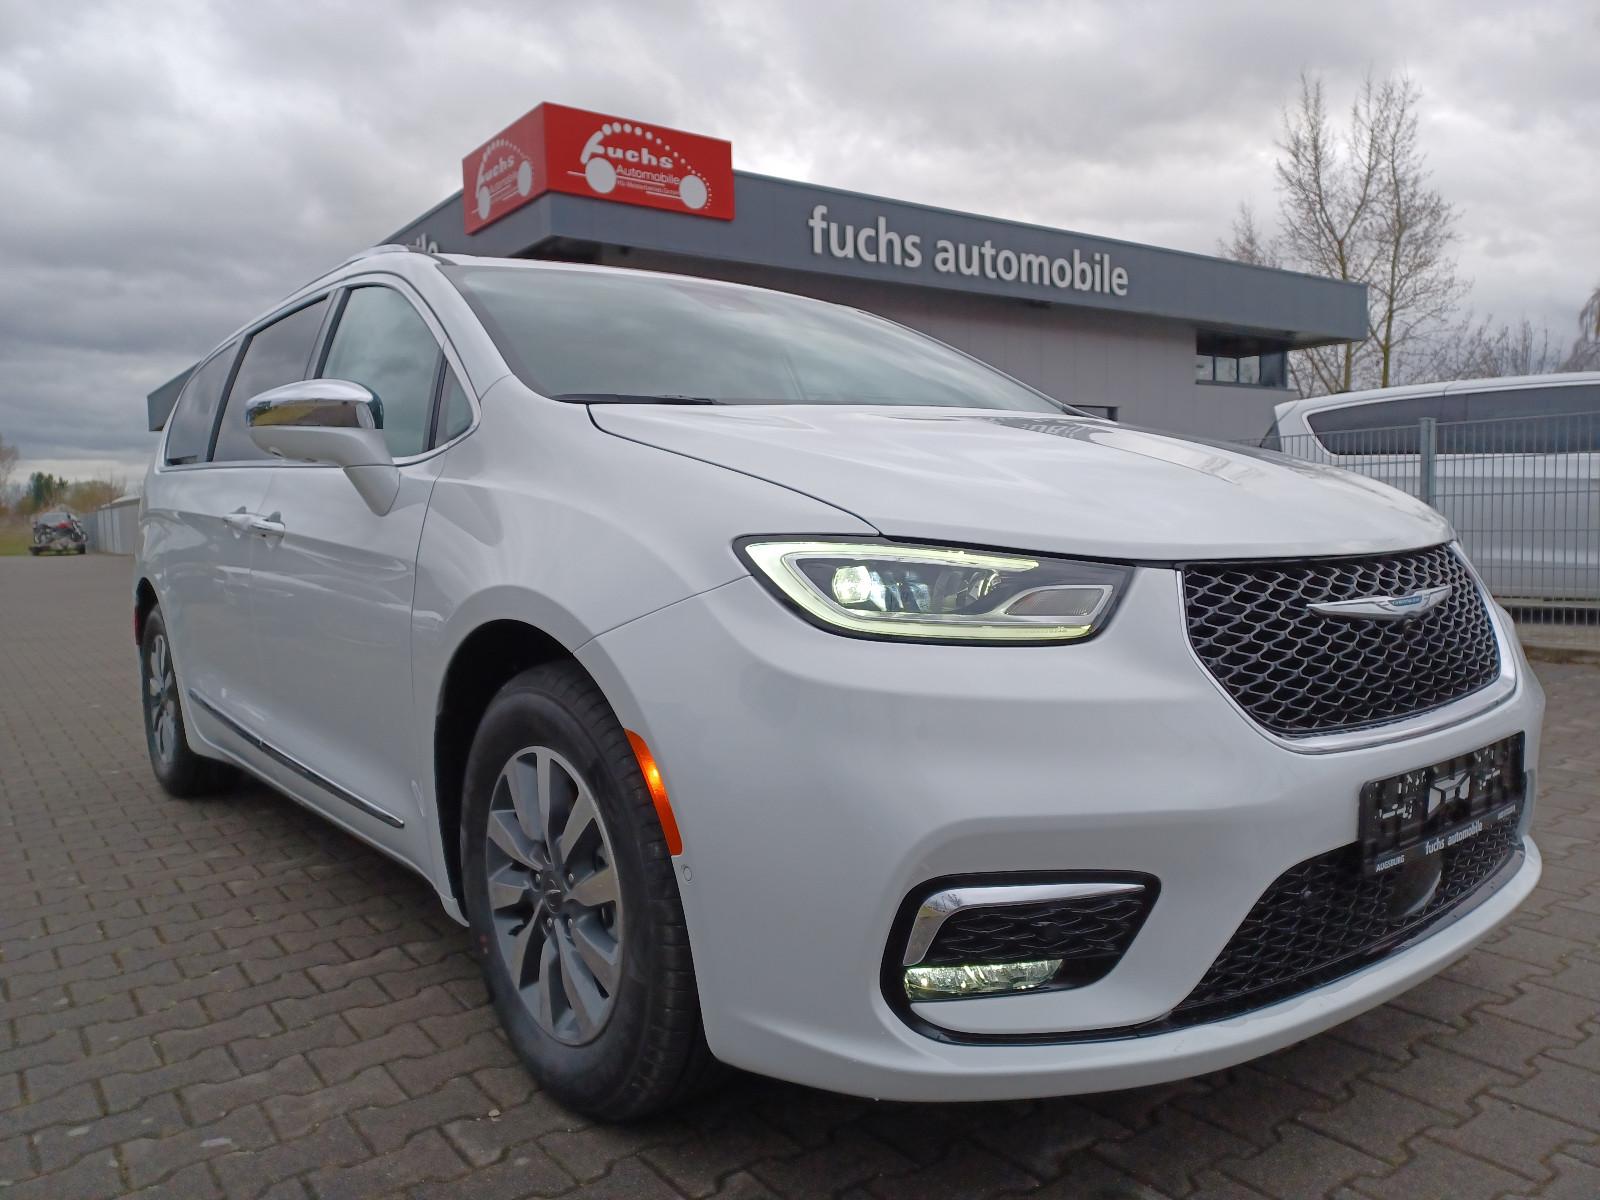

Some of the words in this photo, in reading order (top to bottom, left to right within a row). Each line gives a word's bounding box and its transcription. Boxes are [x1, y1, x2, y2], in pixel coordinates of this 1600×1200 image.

[616, 163, 681, 186] Automobile
[808, 204, 923, 268] fuchs
[934, 238, 1129, 297] automobile
[1425, 837, 1445, 856] fuchs
[1447, 819, 1483, 847] automobile
